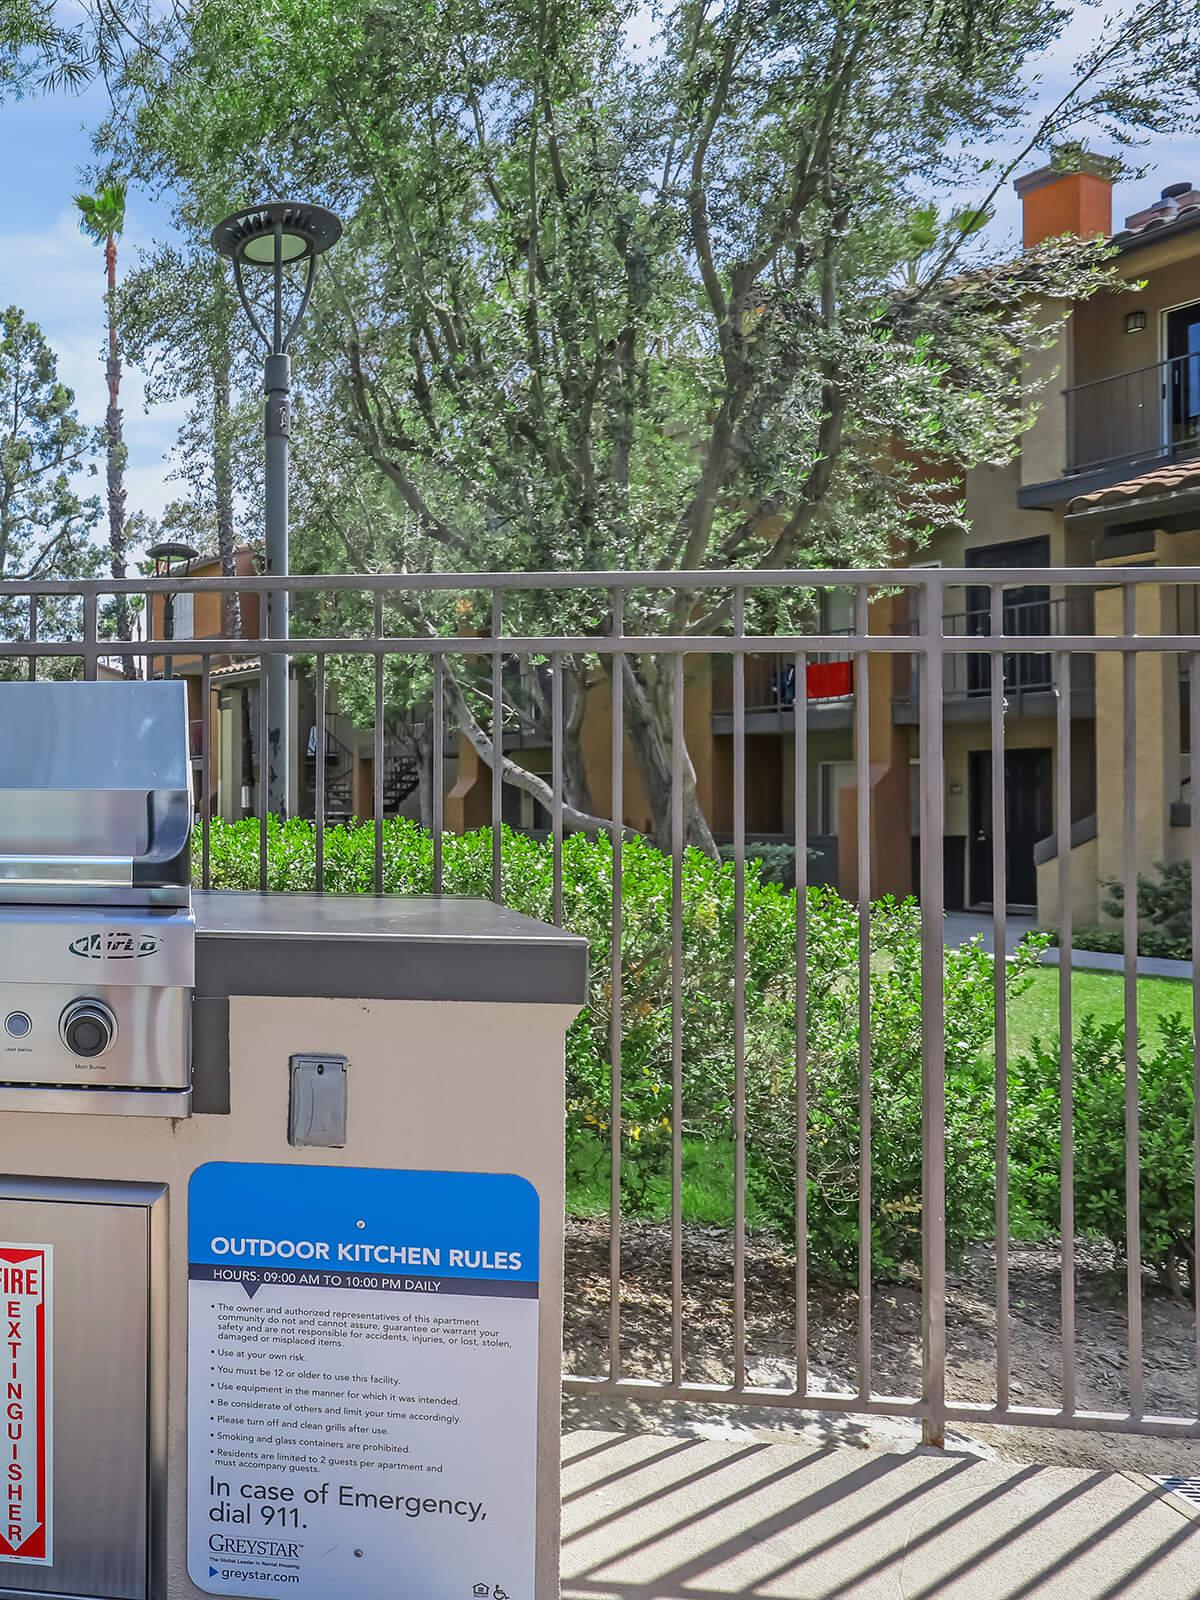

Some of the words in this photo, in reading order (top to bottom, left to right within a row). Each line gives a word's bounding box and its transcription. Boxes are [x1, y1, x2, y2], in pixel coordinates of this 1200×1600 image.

[211, 1237, 329, 1259] OUTDOOR
[338, 1243, 440, 1265] KITCHEN
[450, 1249, 522, 1270] RULES
[214, 1269, 260, 1281] HOURS:
[264, 1272, 296, 1283] 09:00
[299, 1274, 319, 1284] AM
[323, 1275, 342, 1286] TO
[346, 1277, 378, 1288] 10:00
[382, 1278, 400, 1289] PM
[405, 1280, 441, 1291] DAILY
[217, 1314, 265, 1325] community
[267, 1315, 279, 1324] do
[299, 1318, 315, 1326] and
[317, 1320, 347, 1328] cannot
[350, 1322, 380, 1331] assure,
[383, 1324, 428, 1333] guarantee
[442, 1328, 476, 1336] warrant
[218, 1303, 234, 1311] The
[266, 1306, 282, 1314] and
[284, 1307, 330, 1317] authorized
[333, 1312, 400, 1321] representatives
[403, 1314, 412, 1322] of
[414, 1314, 430, 1323] this
[433, 1318, 479, 1326] apartment
[218, 1322, 244, 1333] safety
[246, 1324, 262, 1332] and
[298, 1329, 348, 1338] responsible
[350, 1330, 363, 1338] for
[365, 1331, 409, 1342] accidents,
[412, 1334, 445, 1344] injuries,
[461, 1337, 479, 1346] lost,
[482, 1339, 511, 1349] stolen,
[218, 1332, 258, 1343] damaged
[272, 1336, 316, 1346] misplaced
[318, 1338, 344, 1347] items.
[218, 1348, 234, 1357] Use
[247, 1352, 266, 1360] your
[217, 1365, 233, 1373] You
[260, 1368, 271, 1376] be
[274, 1369, 284, 1377] 12
[297, 1370, 320, 1379] older
[352, 1374, 368, 1382] this
[370, 1375, 400, 1386] facility.
[217, 1382, 233, 1390] Use
[236, 1384, 282, 1394] equipment
[295, 1387, 309, 1395] the
[312, 1390, 344, 1398] manner
[347, 1390, 360, 1399] for
[362, 1392, 387, 1400] which
[390, 1393, 396, 1402] it
[7, 1301, 23, 1541] EXTINGUISHER
[217, 1398, 229, 1407] Be
[231, 1400, 281, 1410] considerate
[283, 1403, 292, 1411] of
[294, 1404, 322, 1413] others
[344, 1407, 362, 1416] limit
[387, 1410, 406, 1419] time
[409, 1413, 461, 1425] accordingly.
[217, 1415, 244, 1424] Please
[247, 1418, 264, 1426] turn
[267, 1418, 279, 1427] off
[282, 1420, 298, 1428] and
[300, 1421, 323, 1430] clean
[325, 1424, 346, 1433] grills
[348, 1424, 369, 1433] after
[217, 1432, 254, 1444] Smoking
[256, 1435, 273, 1443] and
[275, 1436, 296, 1446] glass
[298, 1439, 344, 1448] containers
[217, 1448, 258, 1459] Residents
[277, 1453, 306, 1462] limited
[320, 1456, 326, 1464] 2
[377, 1462, 423, 1471] apartment
[426, 1464, 443, 1472] and
[238, 1461, 287, 1472] accompany
[289, 1465, 320, 1473] guests.
[210, 1475, 231, 1497] In
[239, 1484, 294, 1502] case
[304, 1483, 329, 1504] of
[339, 1486, 486, 1522] Emergency,
[209, 1501, 250, 1524] dial
[261, 1505, 307, 1528] 911.
[222, 1570, 299, 1583] greystar.com
